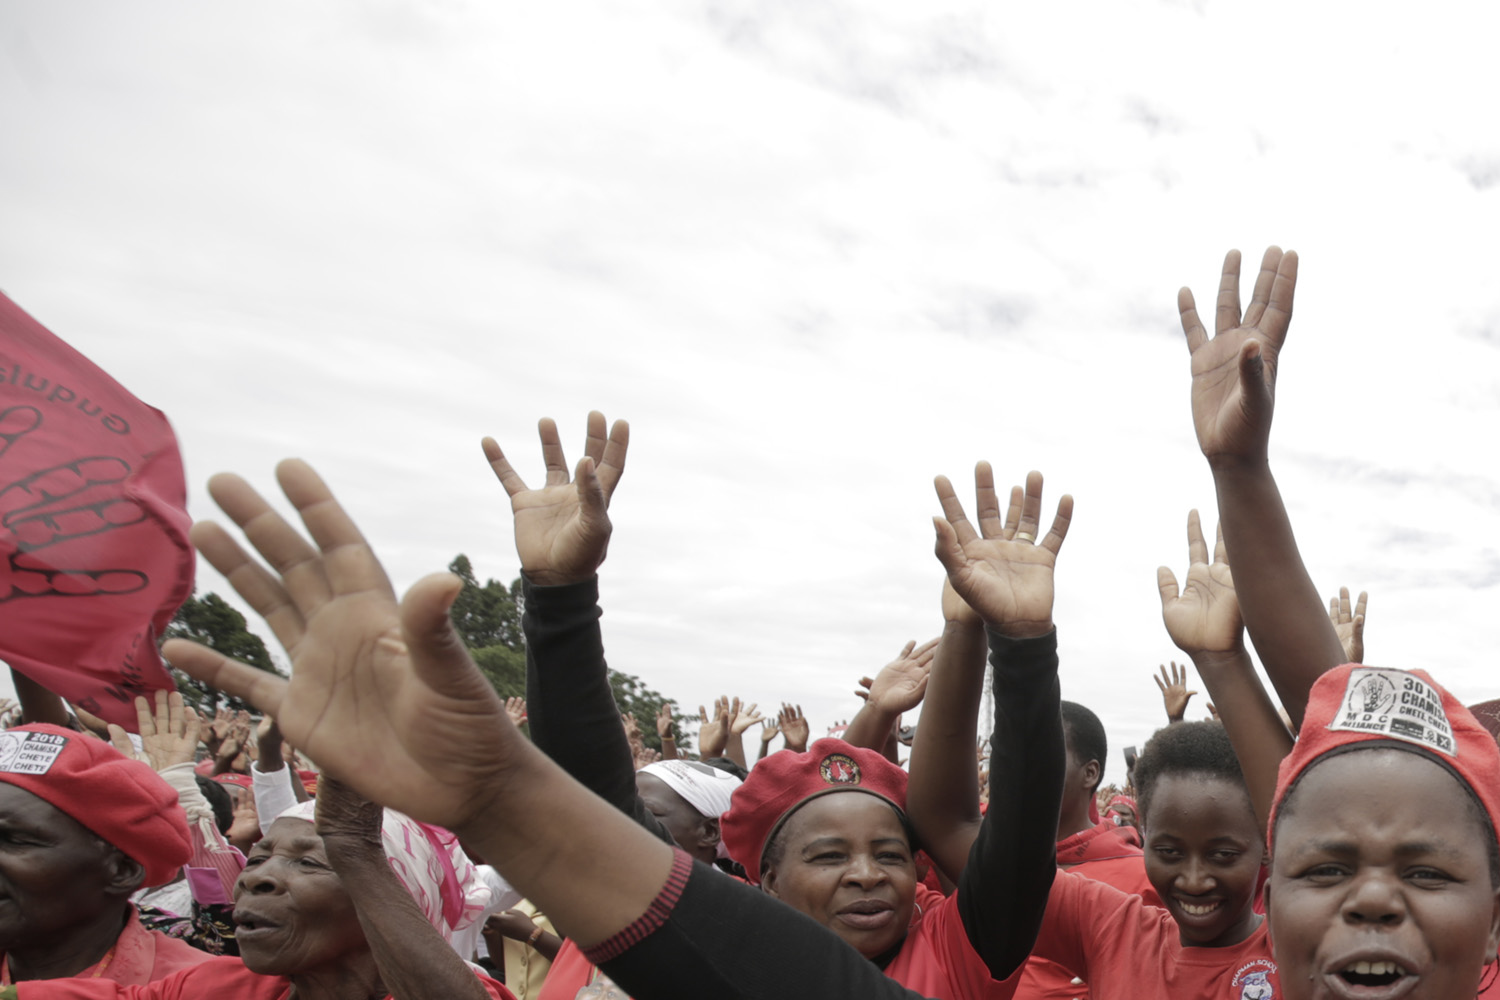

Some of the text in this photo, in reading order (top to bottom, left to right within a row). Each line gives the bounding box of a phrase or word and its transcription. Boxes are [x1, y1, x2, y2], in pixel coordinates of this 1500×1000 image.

[1403, 677, 1424, 694] 30
[31, 733, 65, 744] 2018
[24, 743, 58, 753] CHAMISA
[19, 753, 53, 763] CHETE
[14, 763, 47, 772] CHETE
